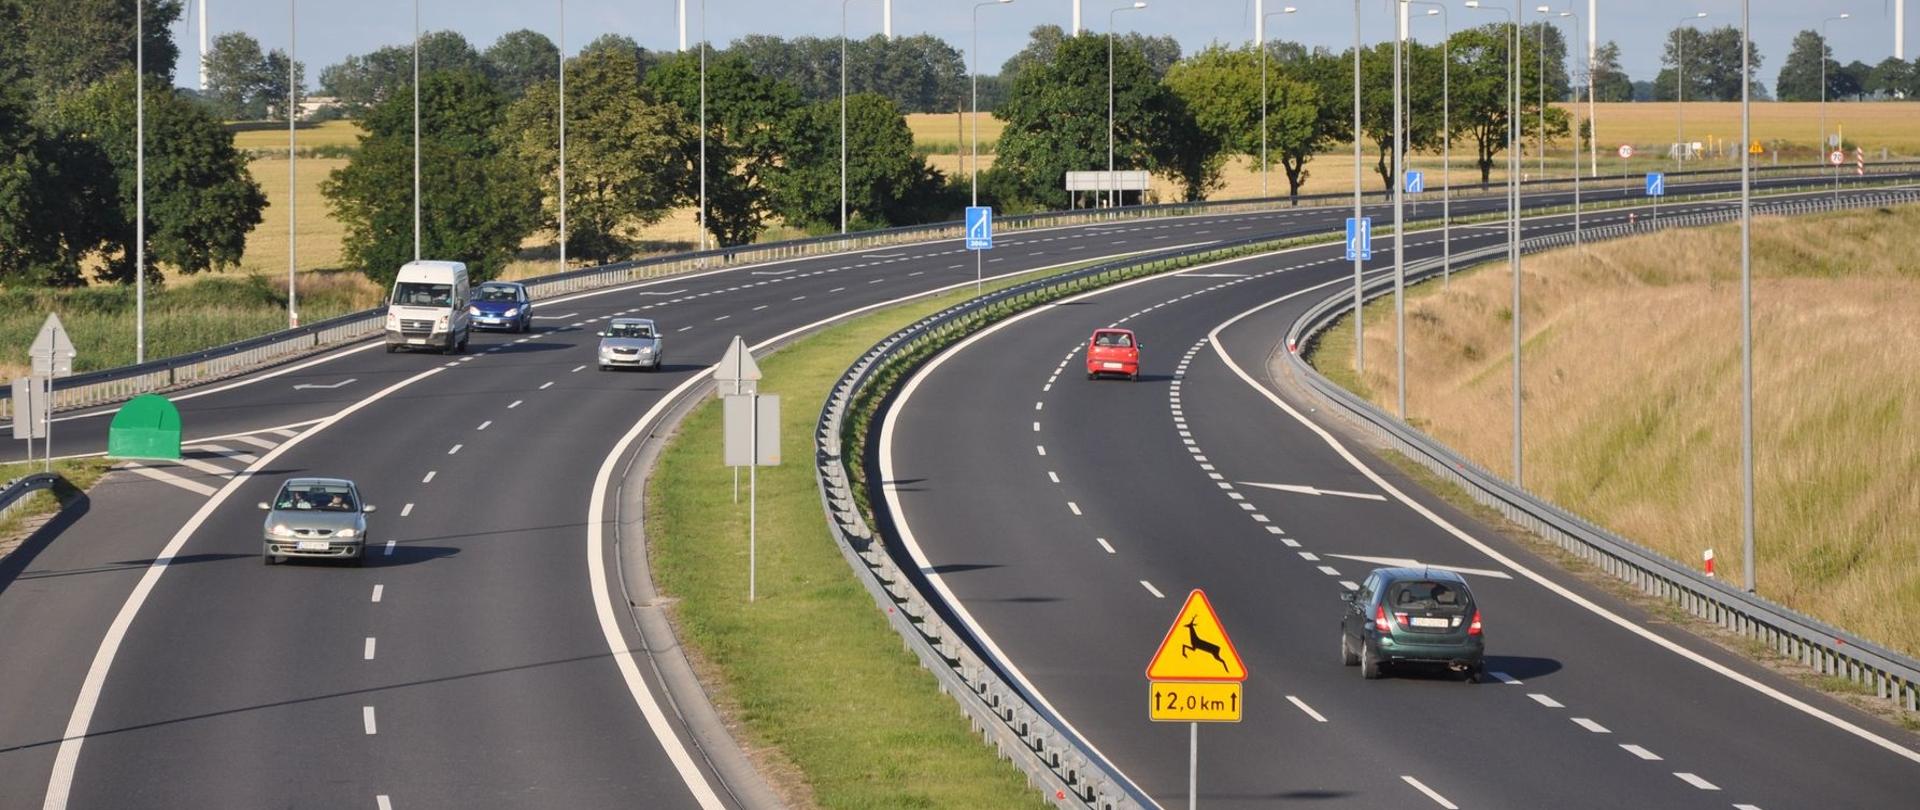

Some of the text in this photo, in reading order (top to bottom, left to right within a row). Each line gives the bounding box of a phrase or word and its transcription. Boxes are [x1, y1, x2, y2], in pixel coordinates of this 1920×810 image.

[1832, 153, 1842, 161] 70
[1167, 692, 1224, 712] 2,0 km
